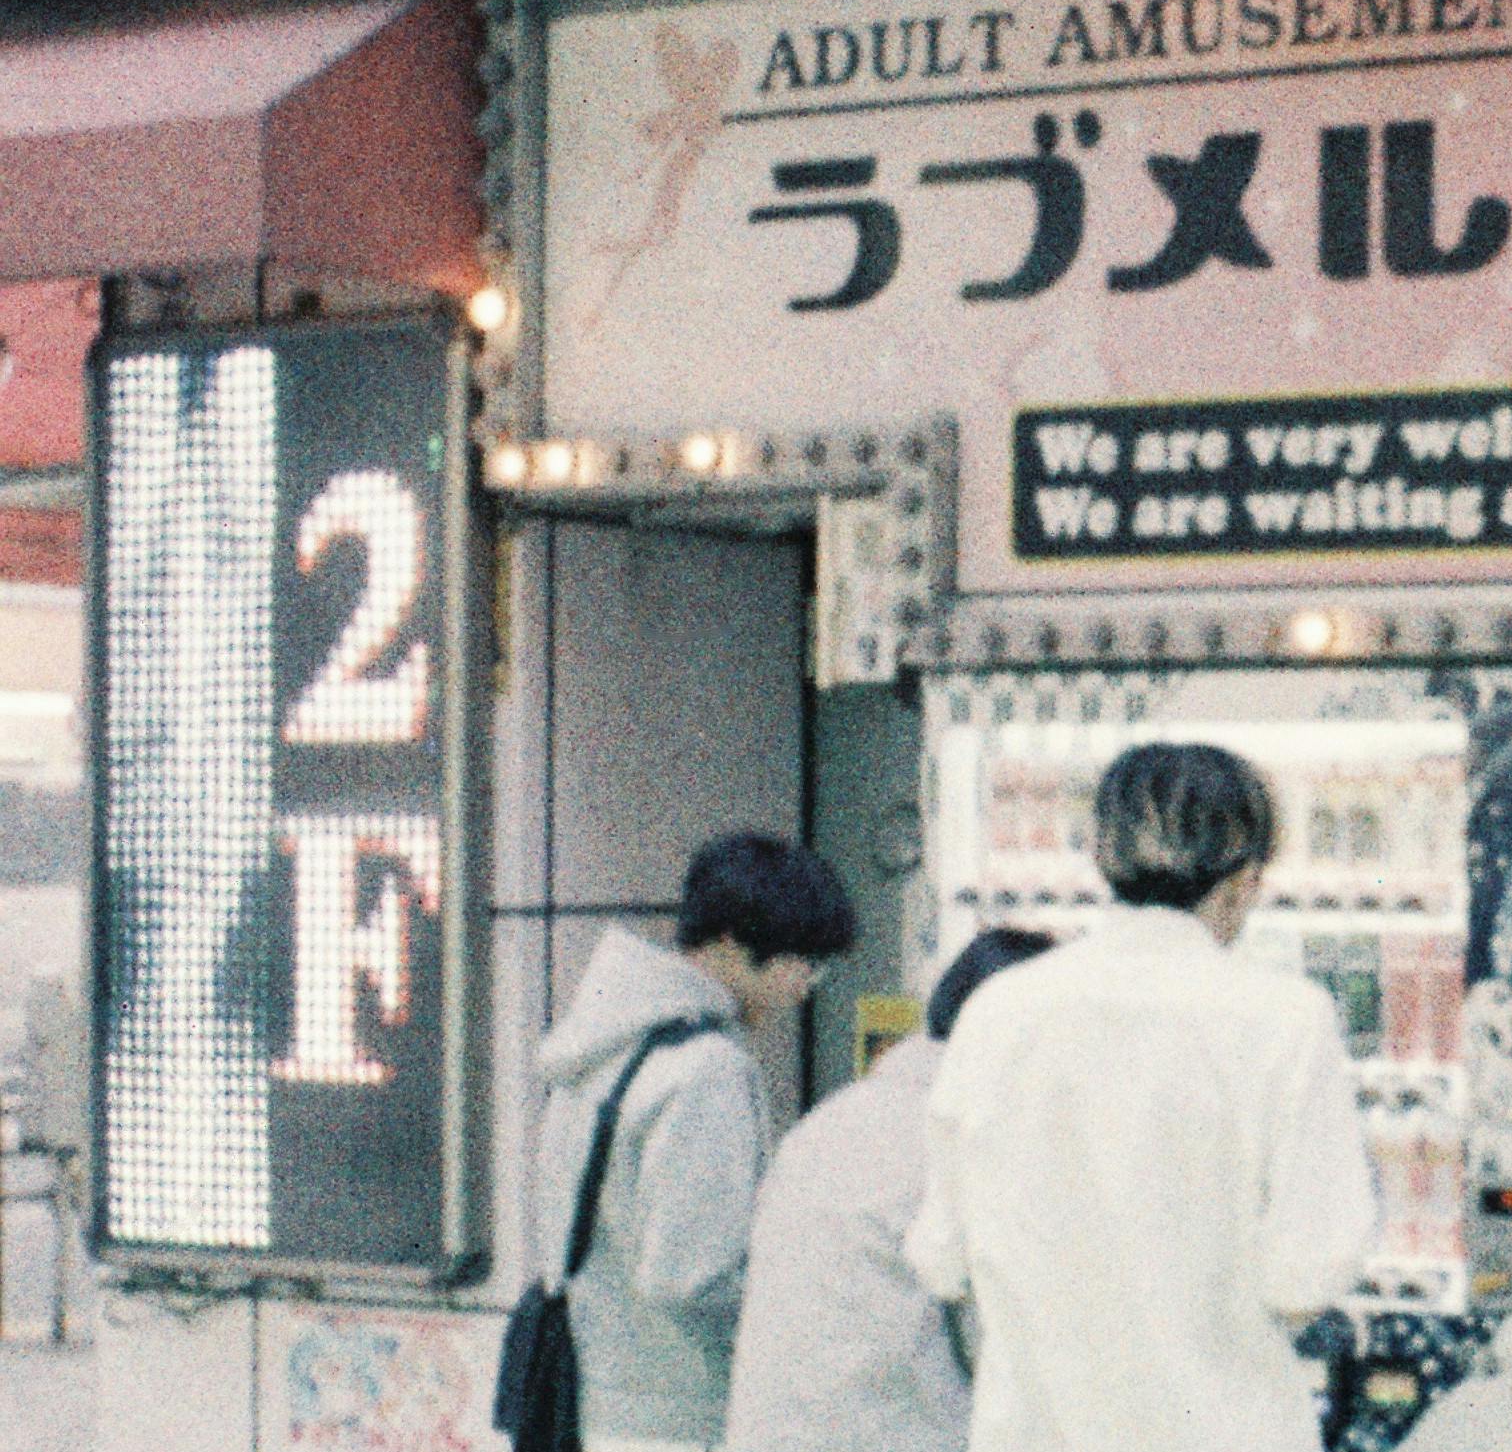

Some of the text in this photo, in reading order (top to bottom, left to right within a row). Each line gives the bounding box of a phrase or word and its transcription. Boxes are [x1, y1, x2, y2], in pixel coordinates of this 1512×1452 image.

[758, 9, 1020, 92] ADULT
[1034, 420, 1120, 475] We
[1132, 428, 1230, 473] are
[1244, 421, 1384, 474] very
[1034, 485, 1120, 540] We
[1132, 493, 1230, 538] are
[1243, 477, 1486, 541] waiting
[272, 467, 442, 1087] 2F
